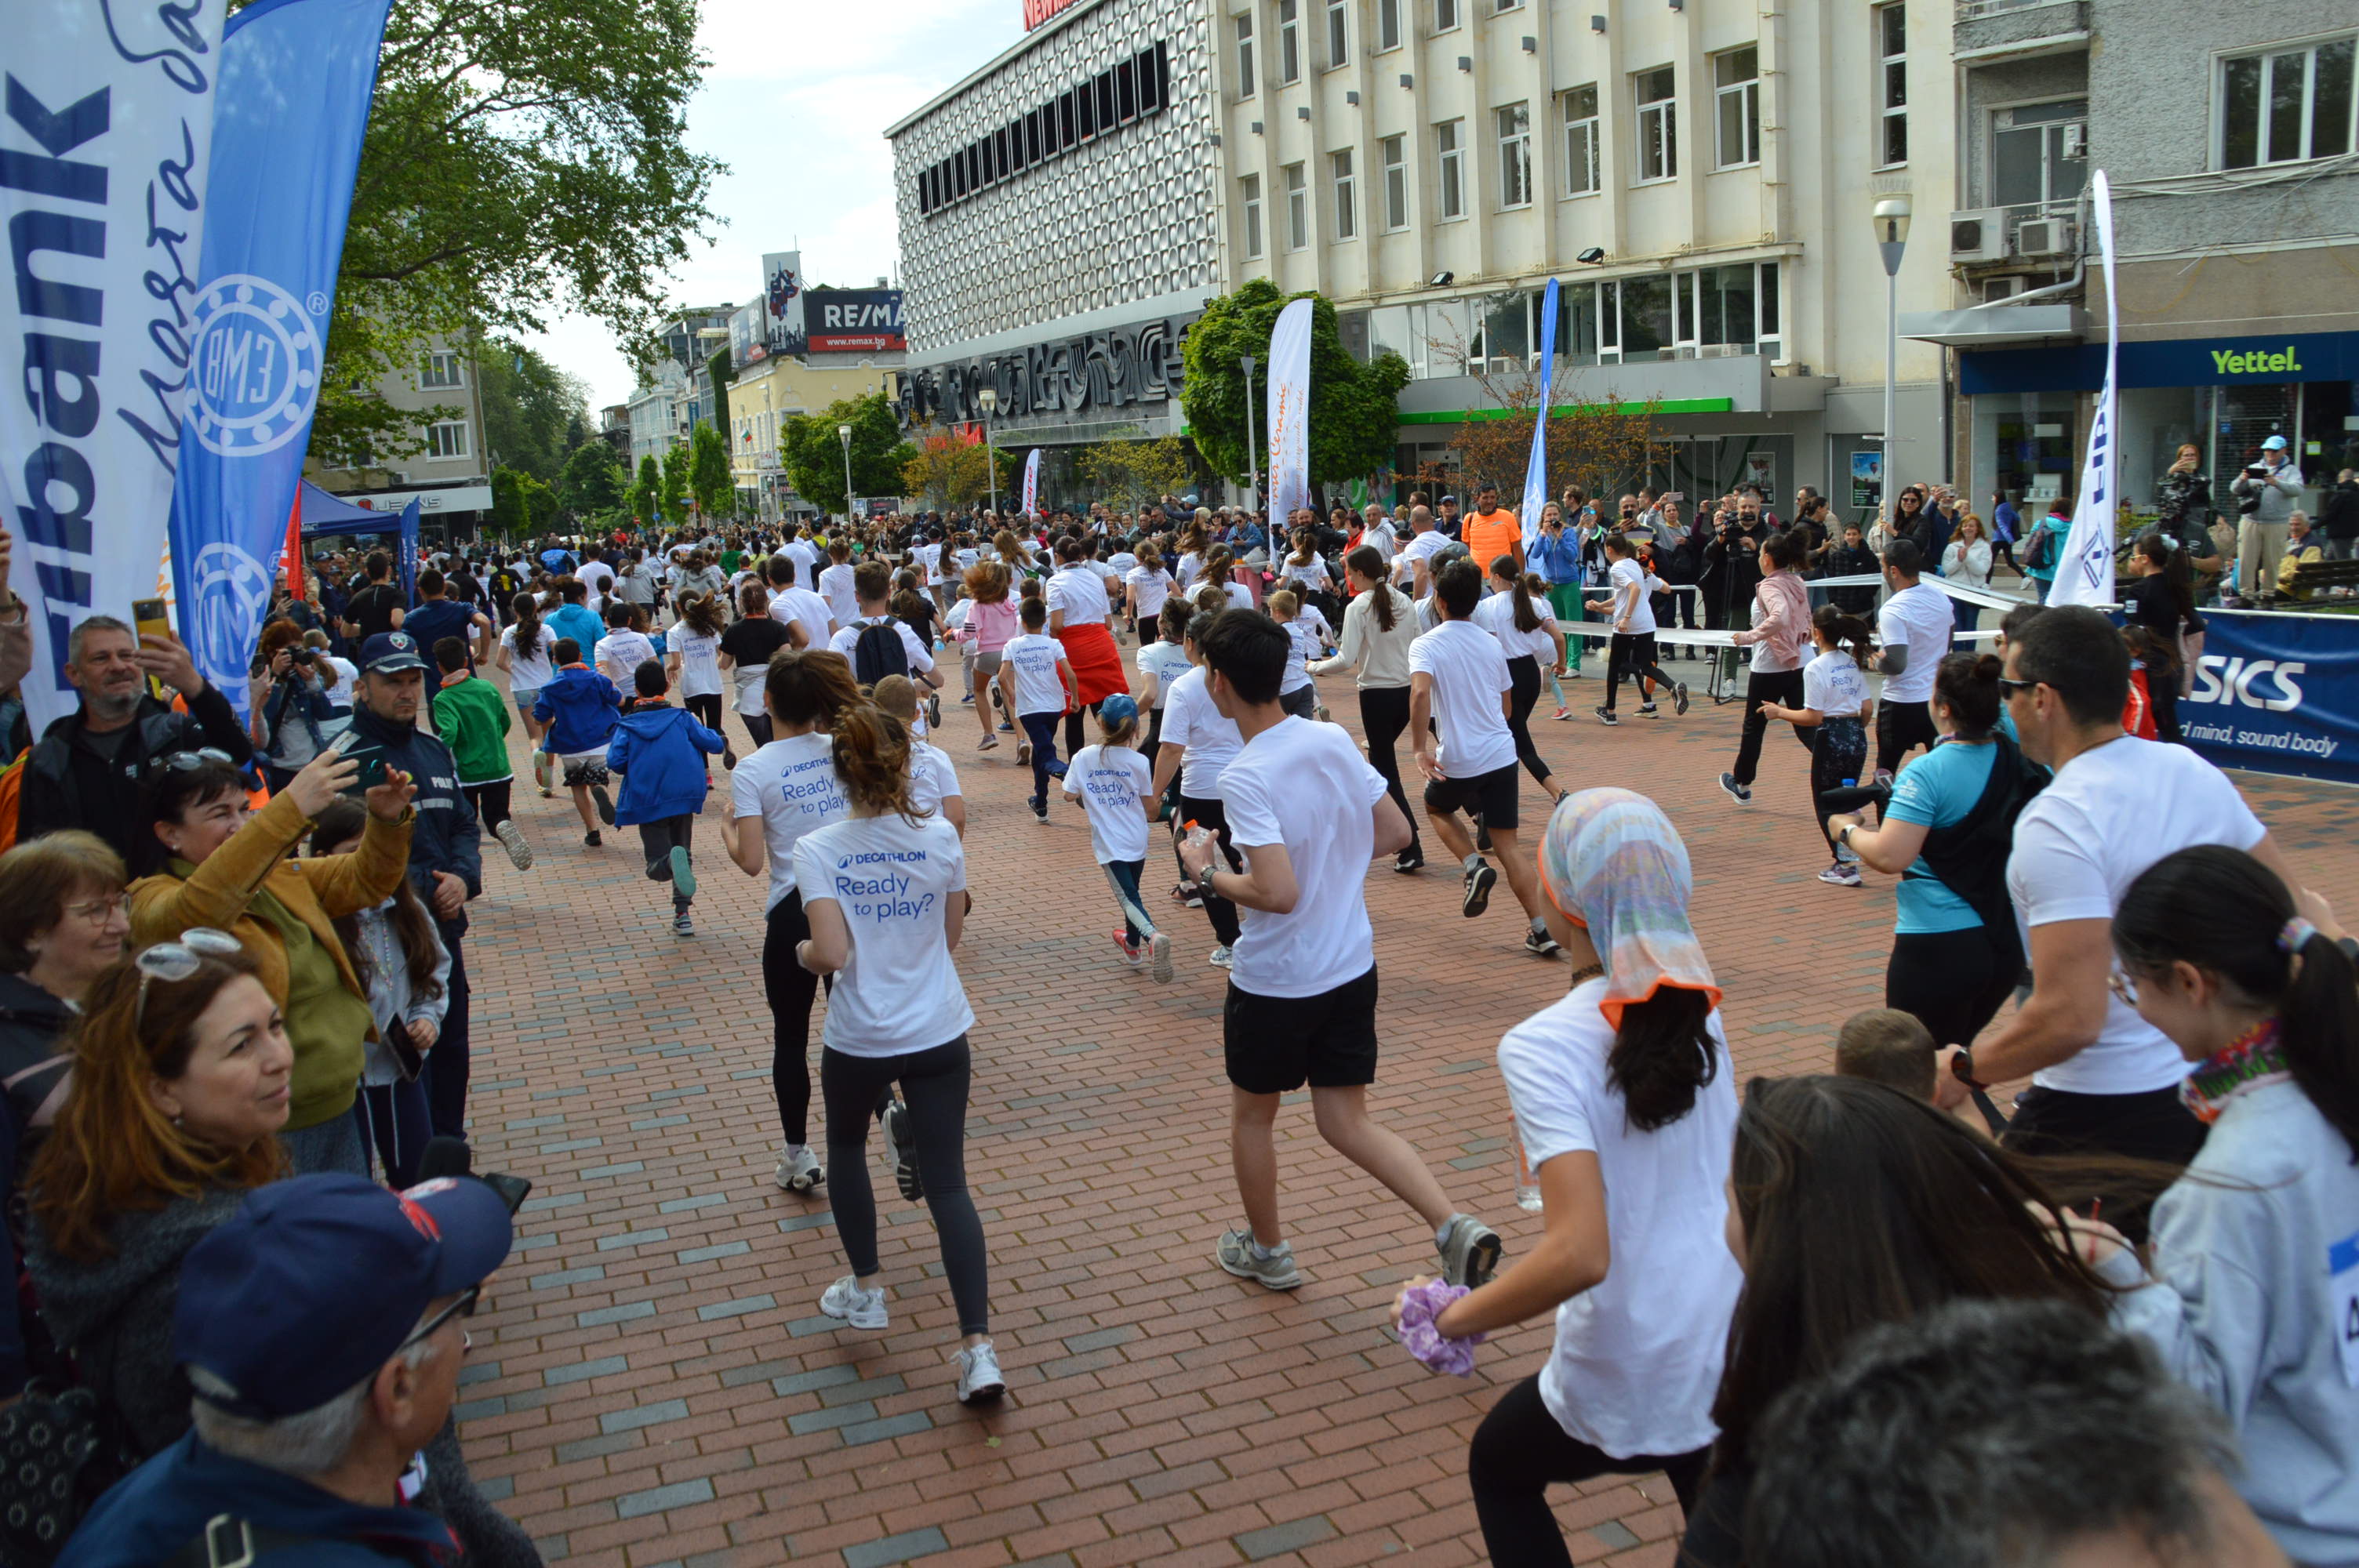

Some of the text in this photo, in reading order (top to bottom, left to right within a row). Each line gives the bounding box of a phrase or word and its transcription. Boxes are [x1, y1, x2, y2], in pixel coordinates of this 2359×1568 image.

[827, 337, 885, 347] www.remax.bg
[2211, 346, 2303, 374] Yettel.
[1015, 655, 1042, 665] Ready
[1031, 661, 1053, 674] play?
[2178, 655, 2306, 712] SICS
[2191, 722, 2234, 745] mind,
[2237, 731, 2291, 749] sound
[2290, 732, 2339, 758] body
[782, 775, 834, 802] Ready
[1086, 782, 1123, 794] Ready
[1107, 792, 1136, 808] play?
[801, 803, 815, 815] to
[856, 851, 927, 865] DECATHLON
[835, 872, 910, 897] Ready
[853, 893, 935, 923] to play?
